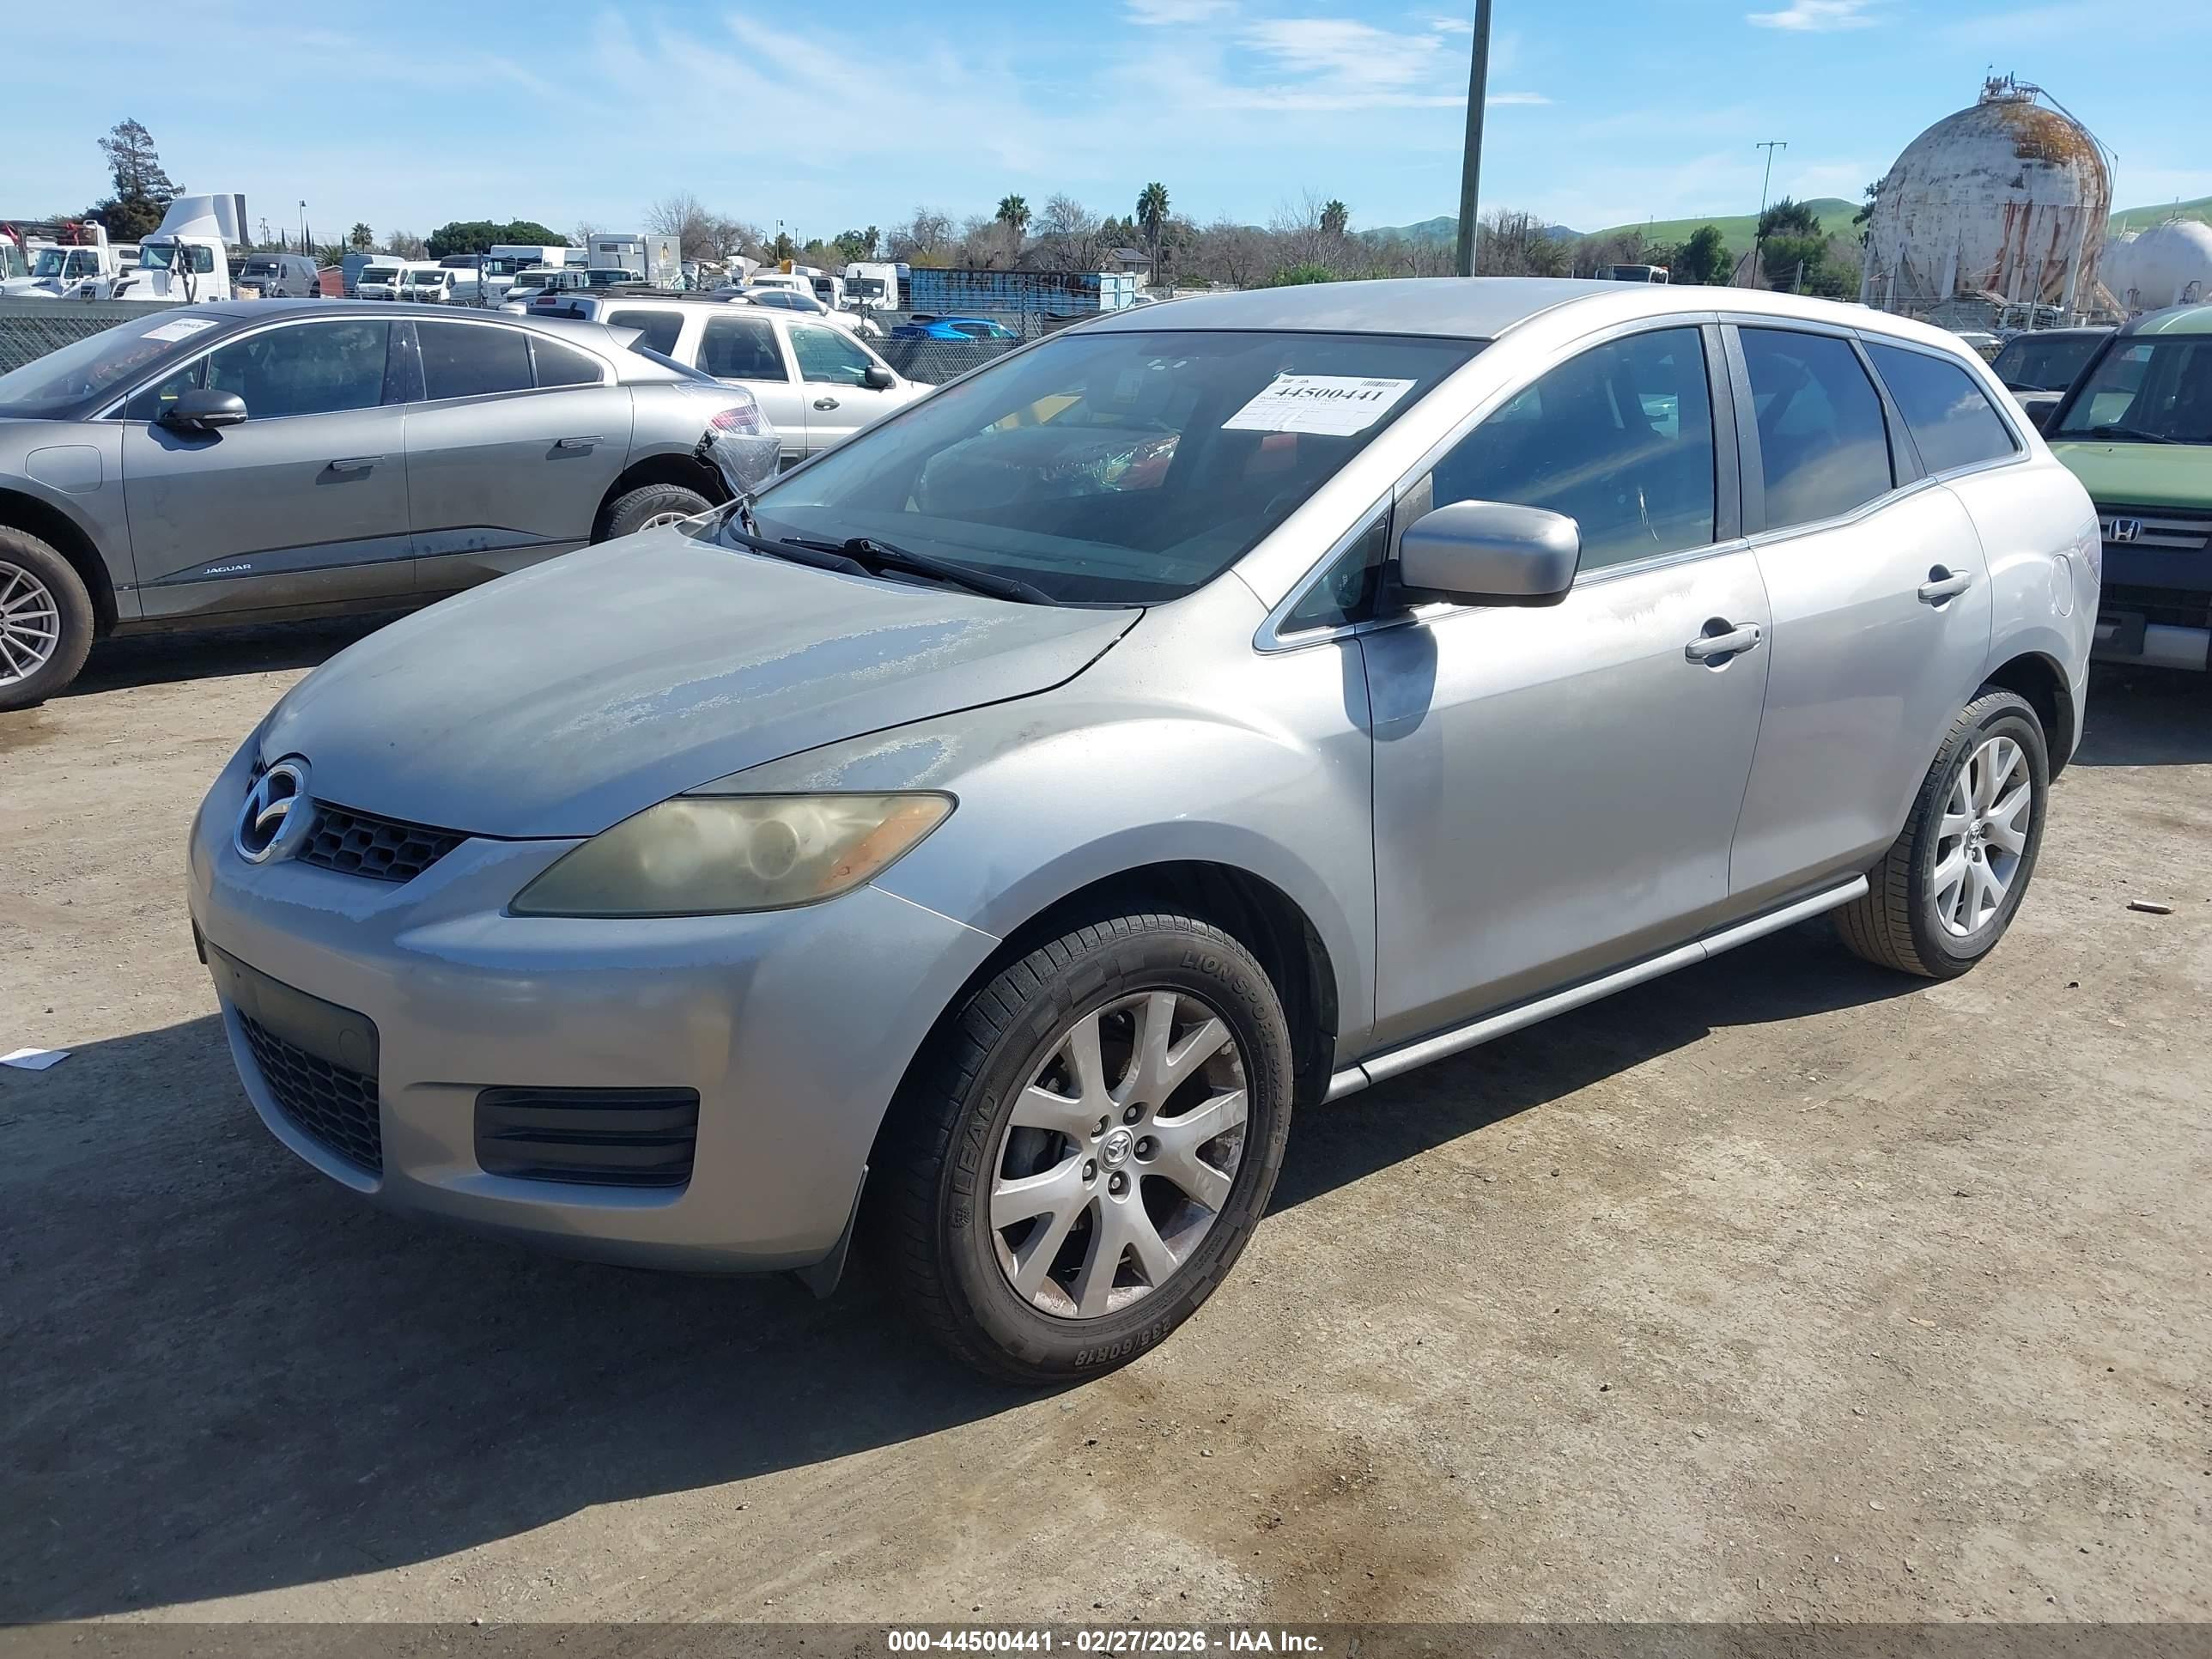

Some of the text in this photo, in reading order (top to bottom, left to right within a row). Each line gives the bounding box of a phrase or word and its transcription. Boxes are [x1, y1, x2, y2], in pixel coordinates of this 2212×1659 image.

[1274, 386, 1384, 401] 44500441
[203, 563, 252, 574] JAGUAR
[1179, 949, 1235, 983] LION
[1231, 976, 1279, 1049] SPORT
[953, 1087, 998, 1196] LEAO
[1074, 1315, 1171, 1368] 235/60R18
